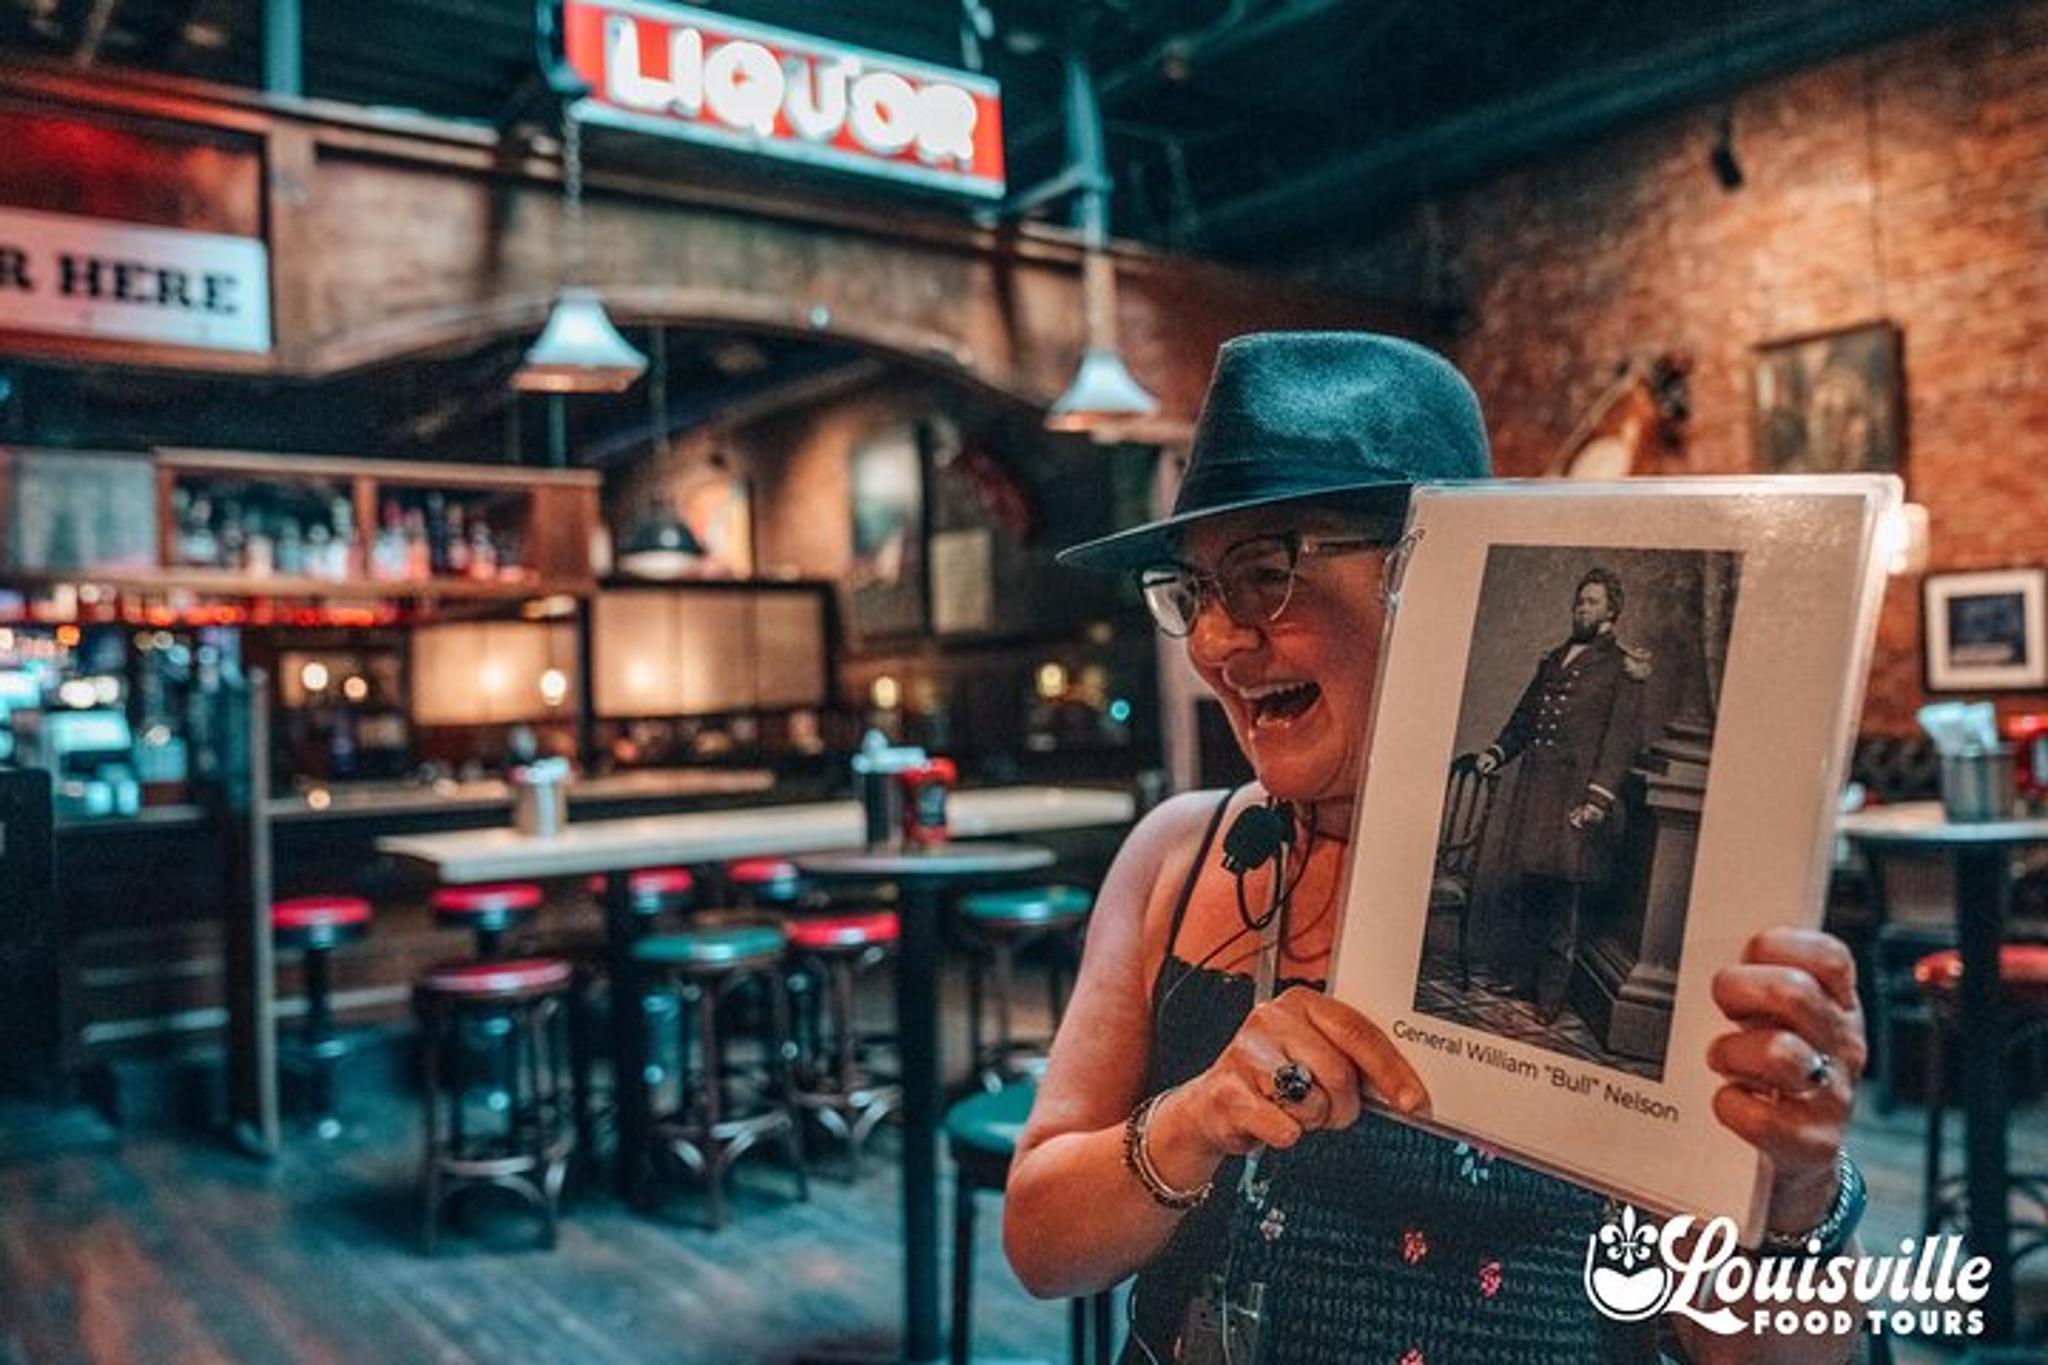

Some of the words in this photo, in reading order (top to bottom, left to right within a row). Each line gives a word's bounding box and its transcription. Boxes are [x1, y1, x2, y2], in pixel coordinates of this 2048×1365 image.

[605, 12, 978, 171] LIQUOR
[60, 253, 240, 315] HERE
[1393, 1020, 1462, 1056] General
[1467, 1041, 1538, 1079] William
[1545, 1065, 1599, 1095] "Bull"
[1604, 1084, 1679, 1122] Nelson
